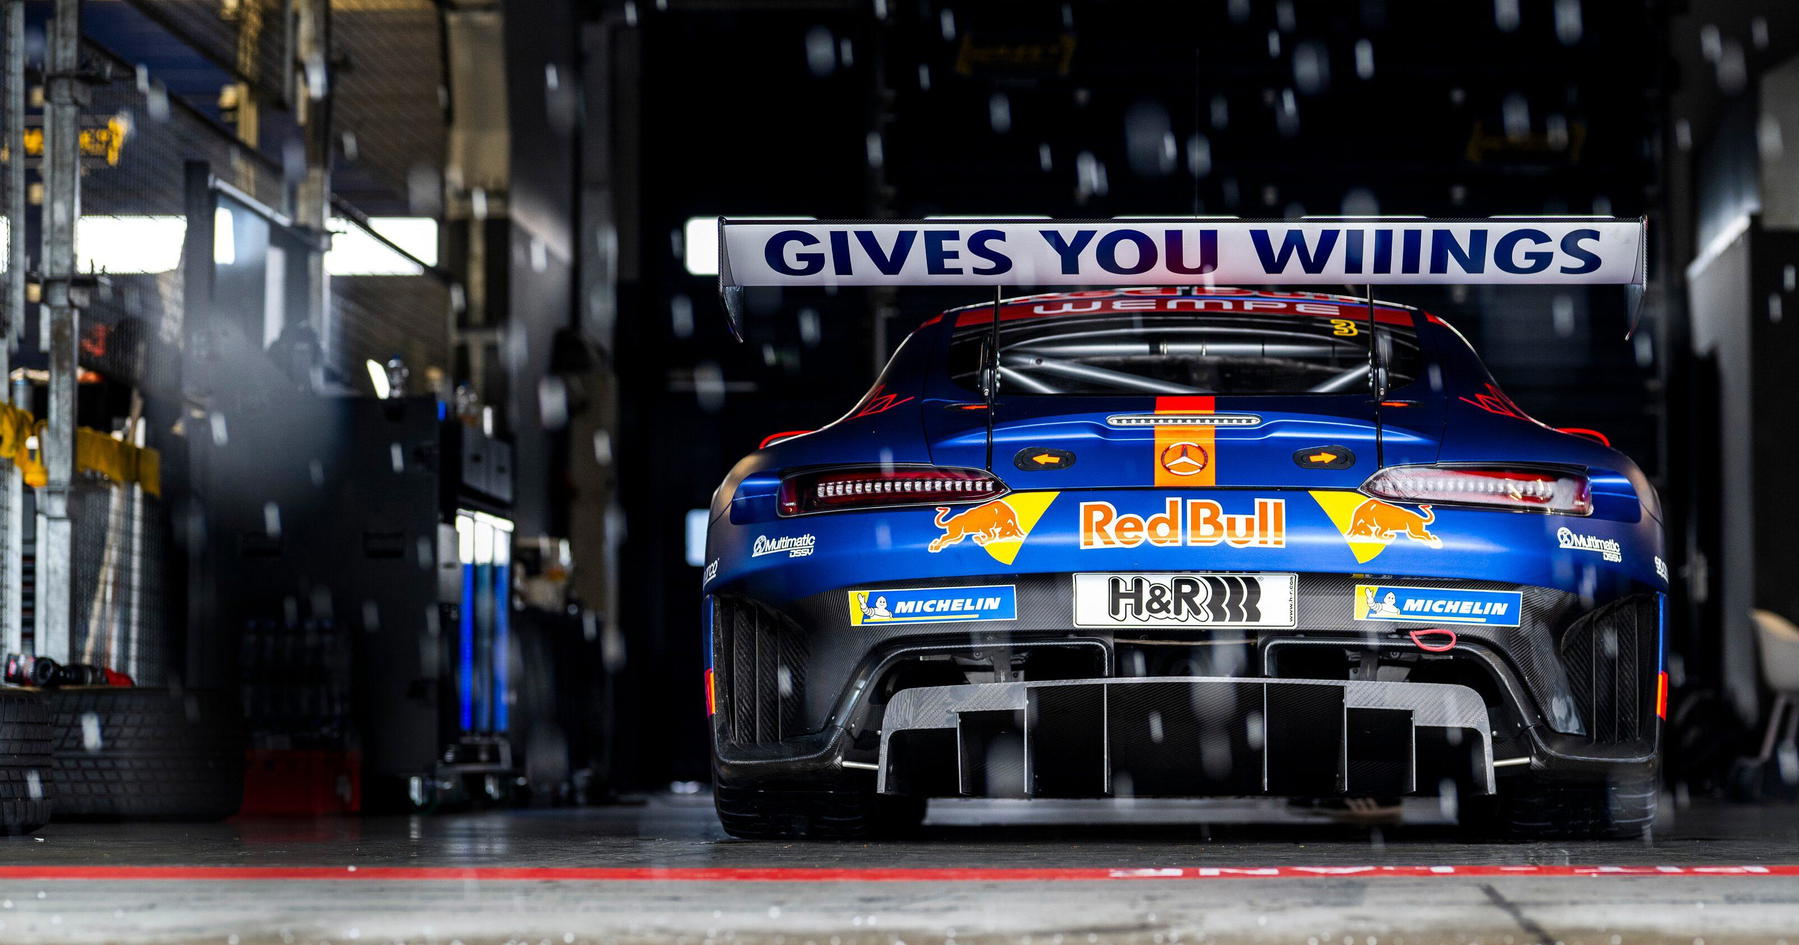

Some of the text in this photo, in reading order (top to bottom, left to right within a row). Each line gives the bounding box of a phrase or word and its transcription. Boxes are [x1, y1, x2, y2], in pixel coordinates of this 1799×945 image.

[763, 228, 1603, 276] GIVES YOU WIIINGS
[1032, 298, 1341, 316] WEMPE
[1330, 319, 1358, 336] 3
[1080, 497, 1286, 549] Red Bull
[765, 533, 816, 551] Multimatic
[1572, 533, 1620, 553] Multimatic
[895, 597, 1002, 614] MICHELIN
[1108, 576, 1209, 622] H&R
[1402, 599, 1509, 616] MICHELIN
